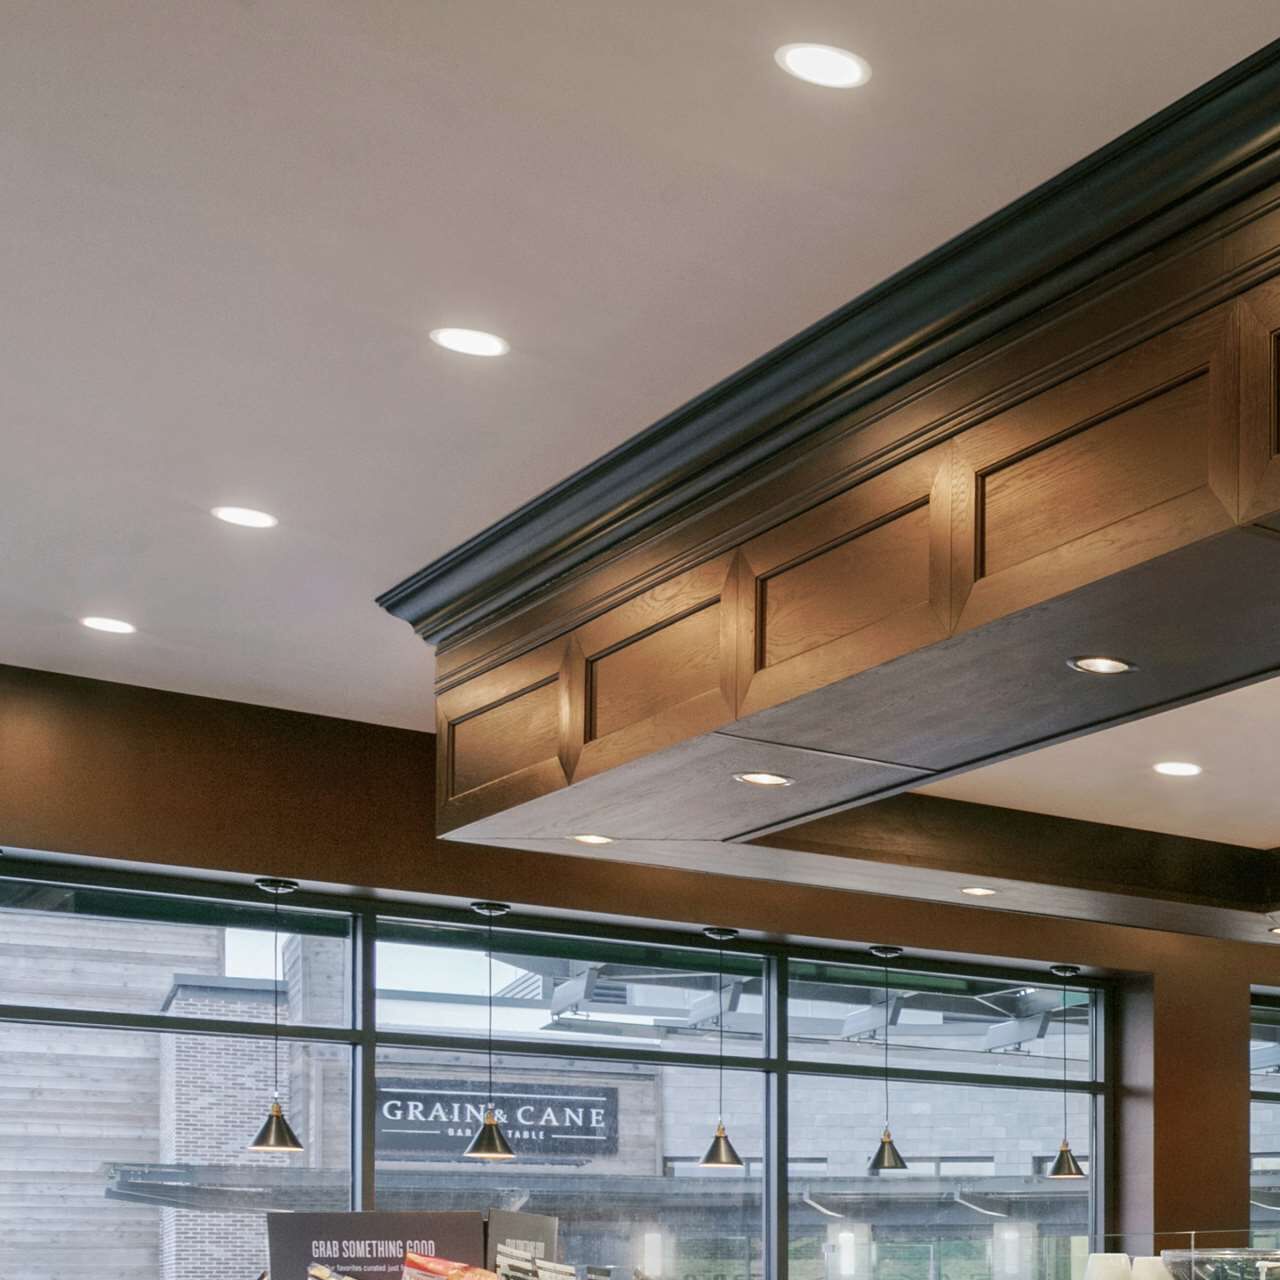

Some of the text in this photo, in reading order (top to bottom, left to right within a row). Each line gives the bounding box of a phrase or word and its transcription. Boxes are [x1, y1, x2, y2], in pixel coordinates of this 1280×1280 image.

[382, 1100, 486, 1123] GRAIN
[517, 1105, 606, 1127] CANE
[508, 1129, 545, 1140] TABLE
[312, 1240, 435, 1258] GRAB SOMETHING GOOD
